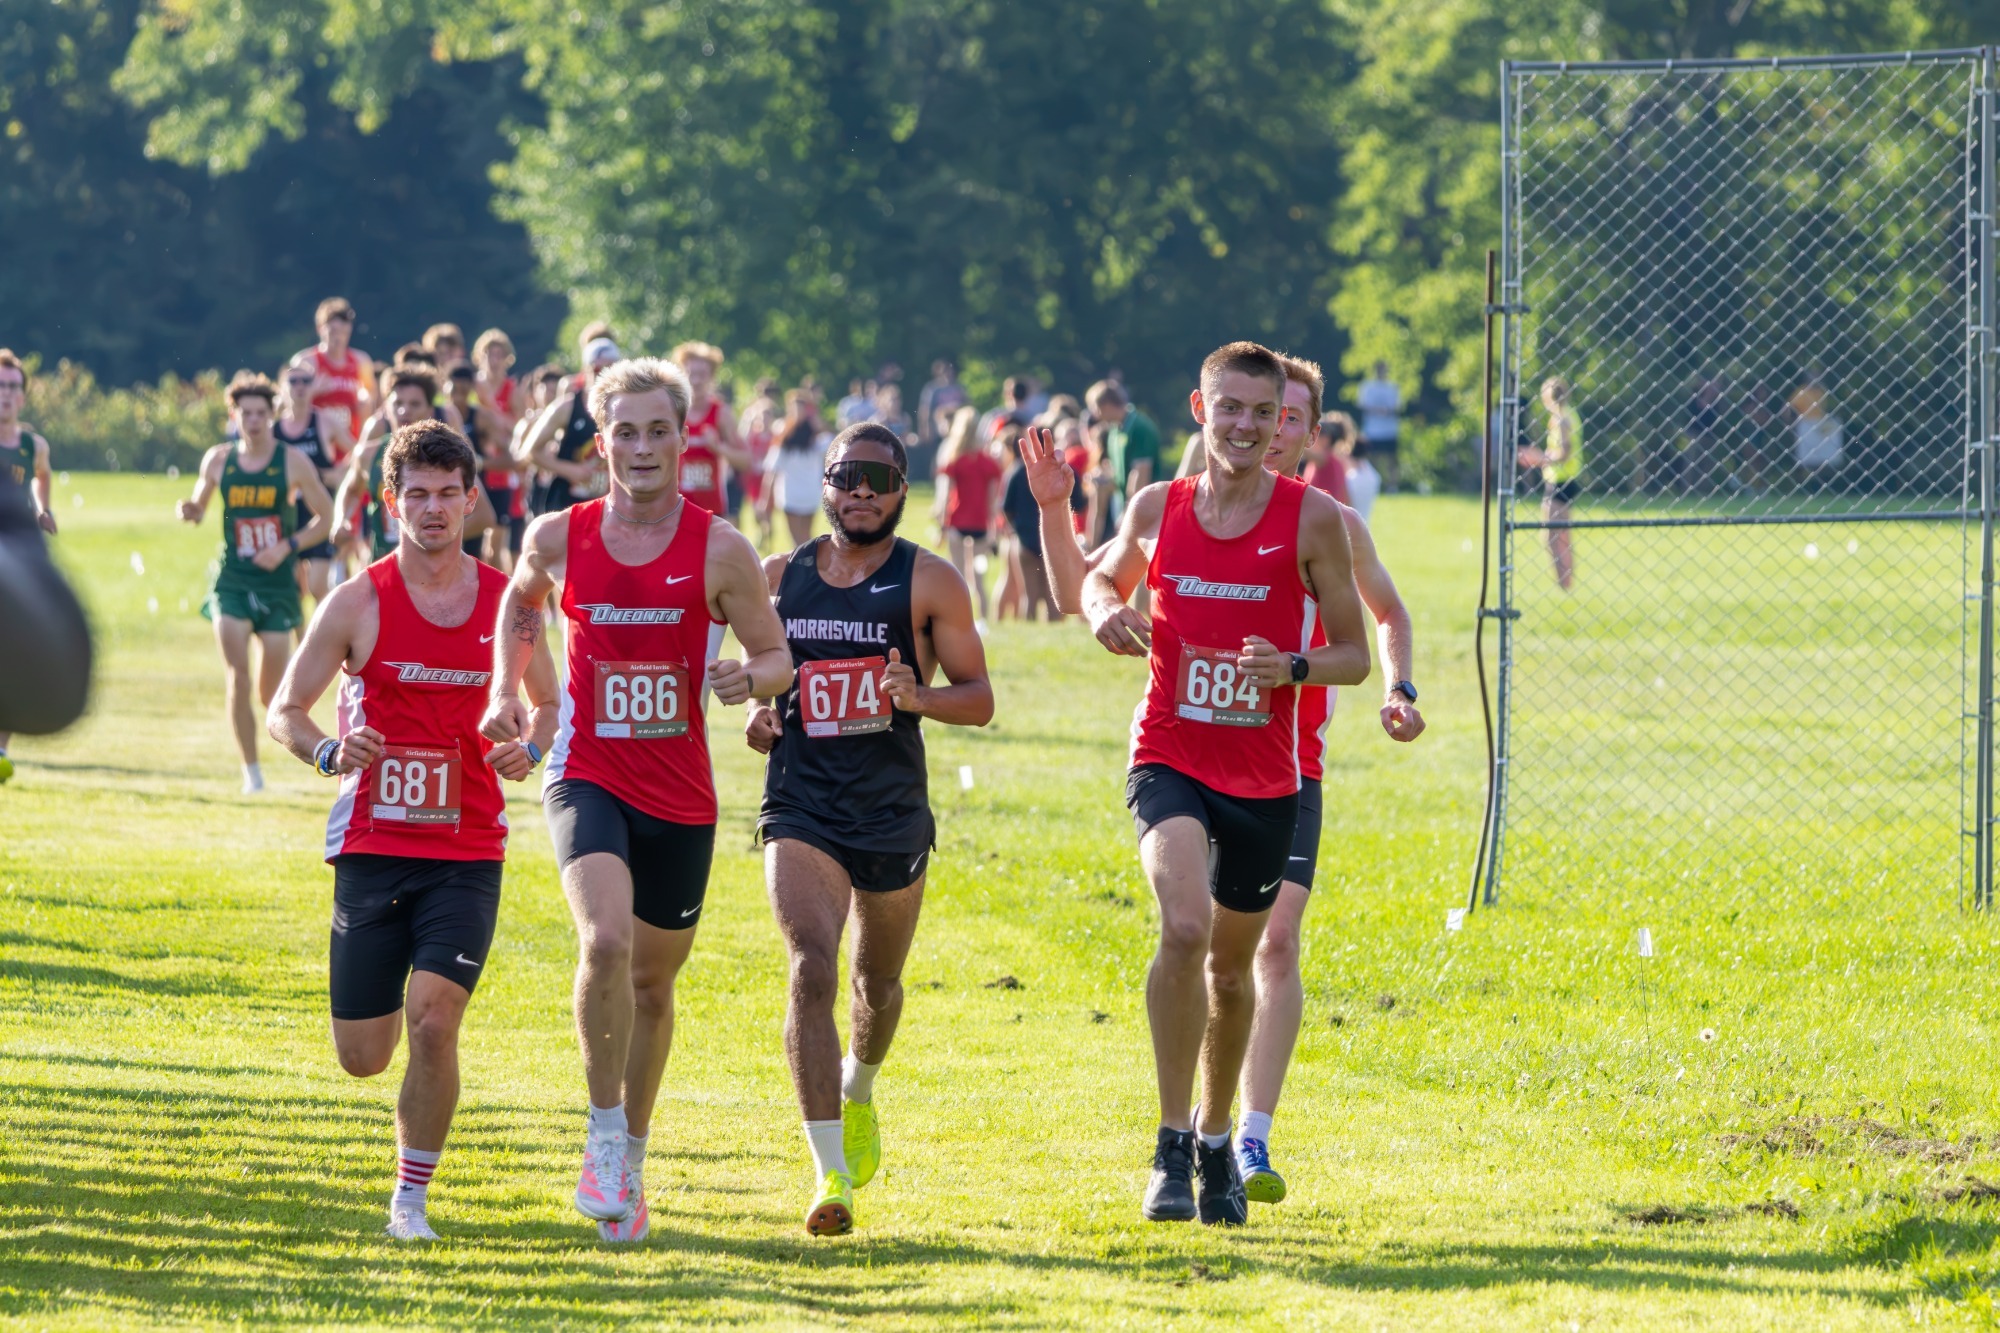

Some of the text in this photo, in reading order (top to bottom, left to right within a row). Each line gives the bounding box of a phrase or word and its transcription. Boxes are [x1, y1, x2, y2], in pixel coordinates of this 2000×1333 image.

[786, 618, 888, 644] MORRISVILLE
[605, 674, 678, 722] 686
[809, 670, 880, 720] 674
[1187, 659, 1260, 710] 684
[380, 758, 449, 807] 681
